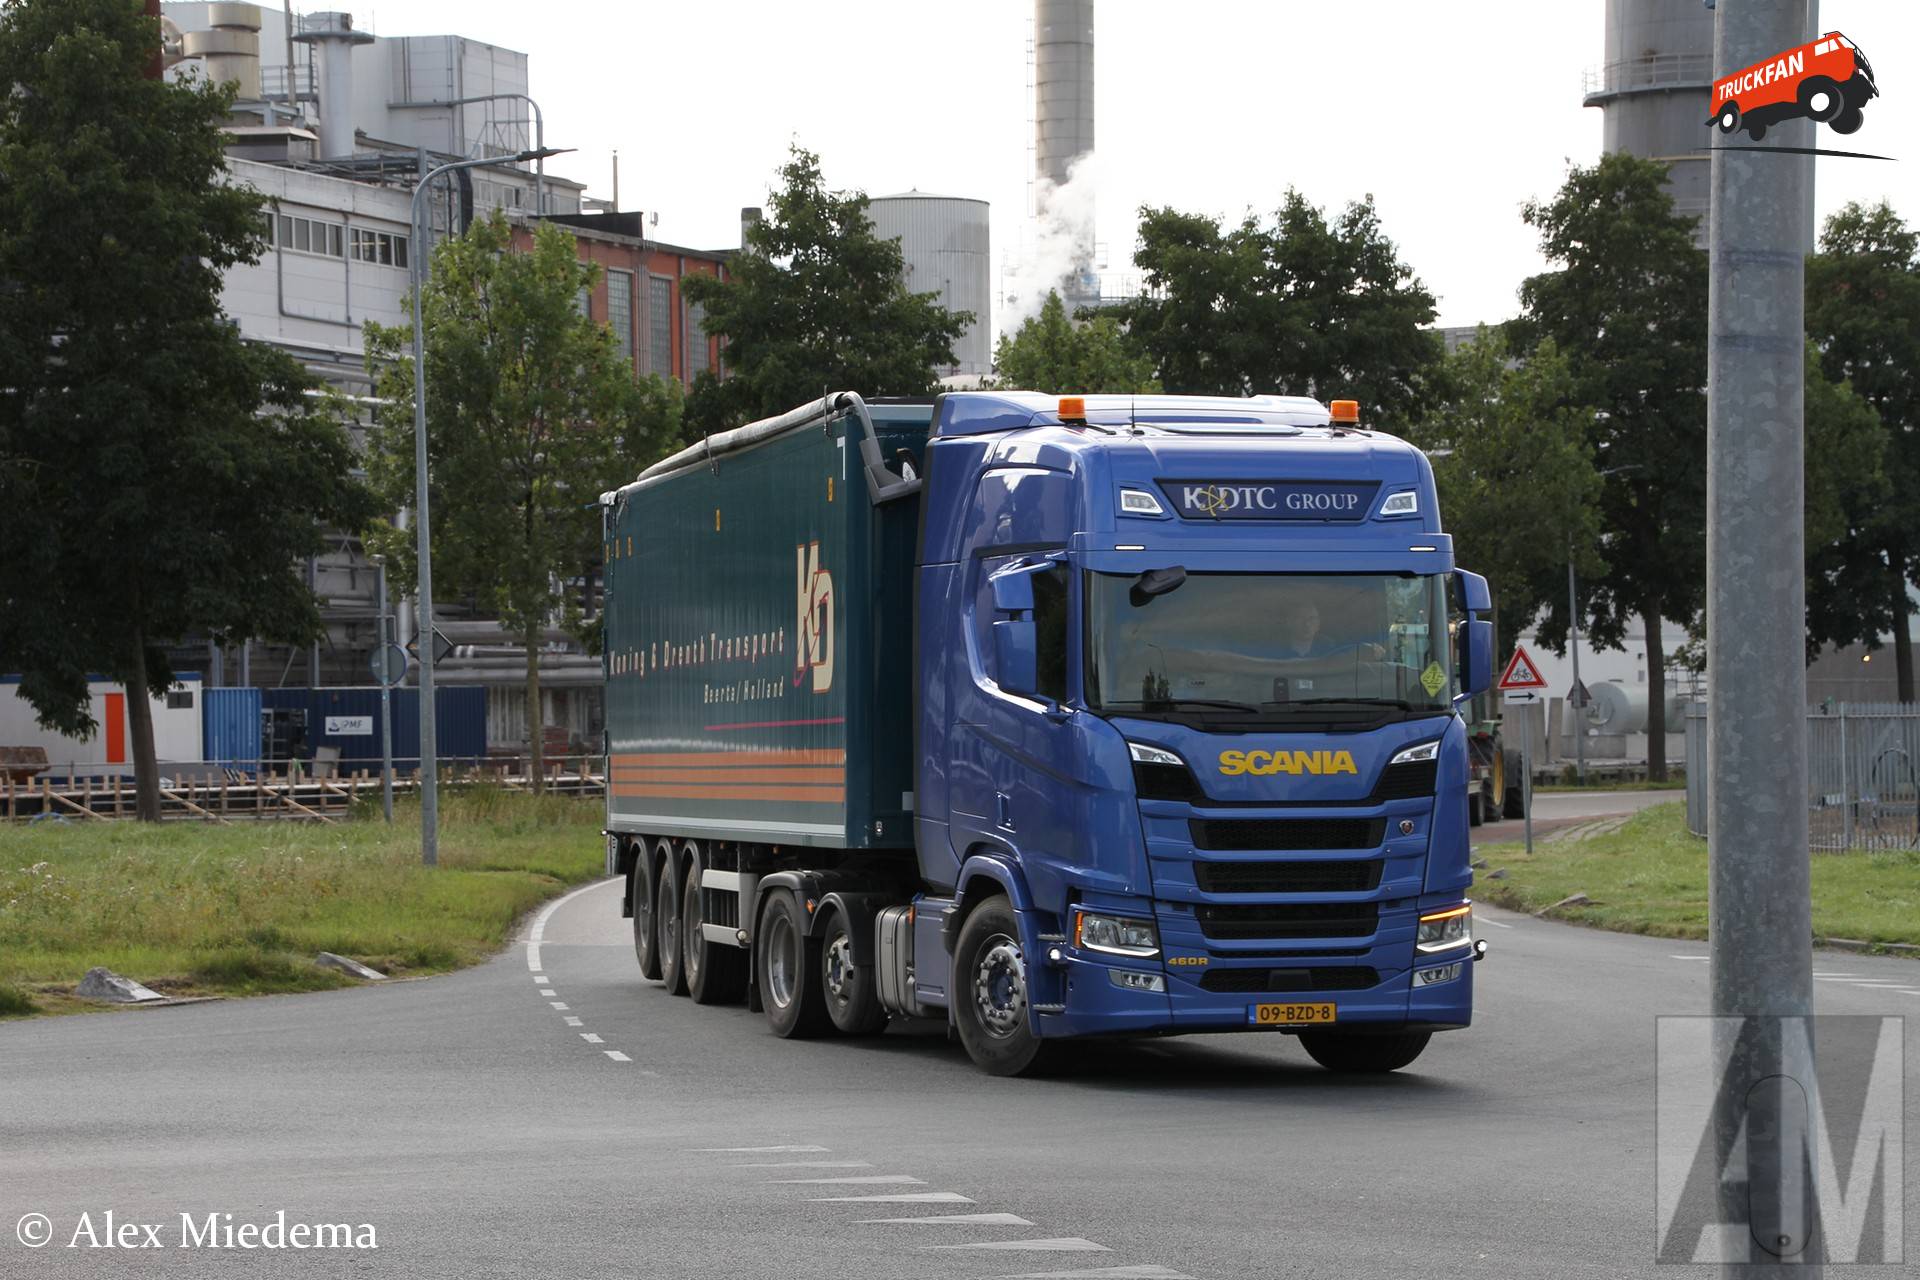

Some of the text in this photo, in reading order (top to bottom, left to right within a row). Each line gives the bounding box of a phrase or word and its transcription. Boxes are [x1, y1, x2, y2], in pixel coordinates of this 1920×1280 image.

[1285, 493, 1358, 510] GROUP
[710, 626, 784, 664] Transport
[1218, 750, 1358, 775] SCANIA
[1167, 957, 1208, 966] 460R
[1260, 1006, 1330, 1021] 09-BZD-8
